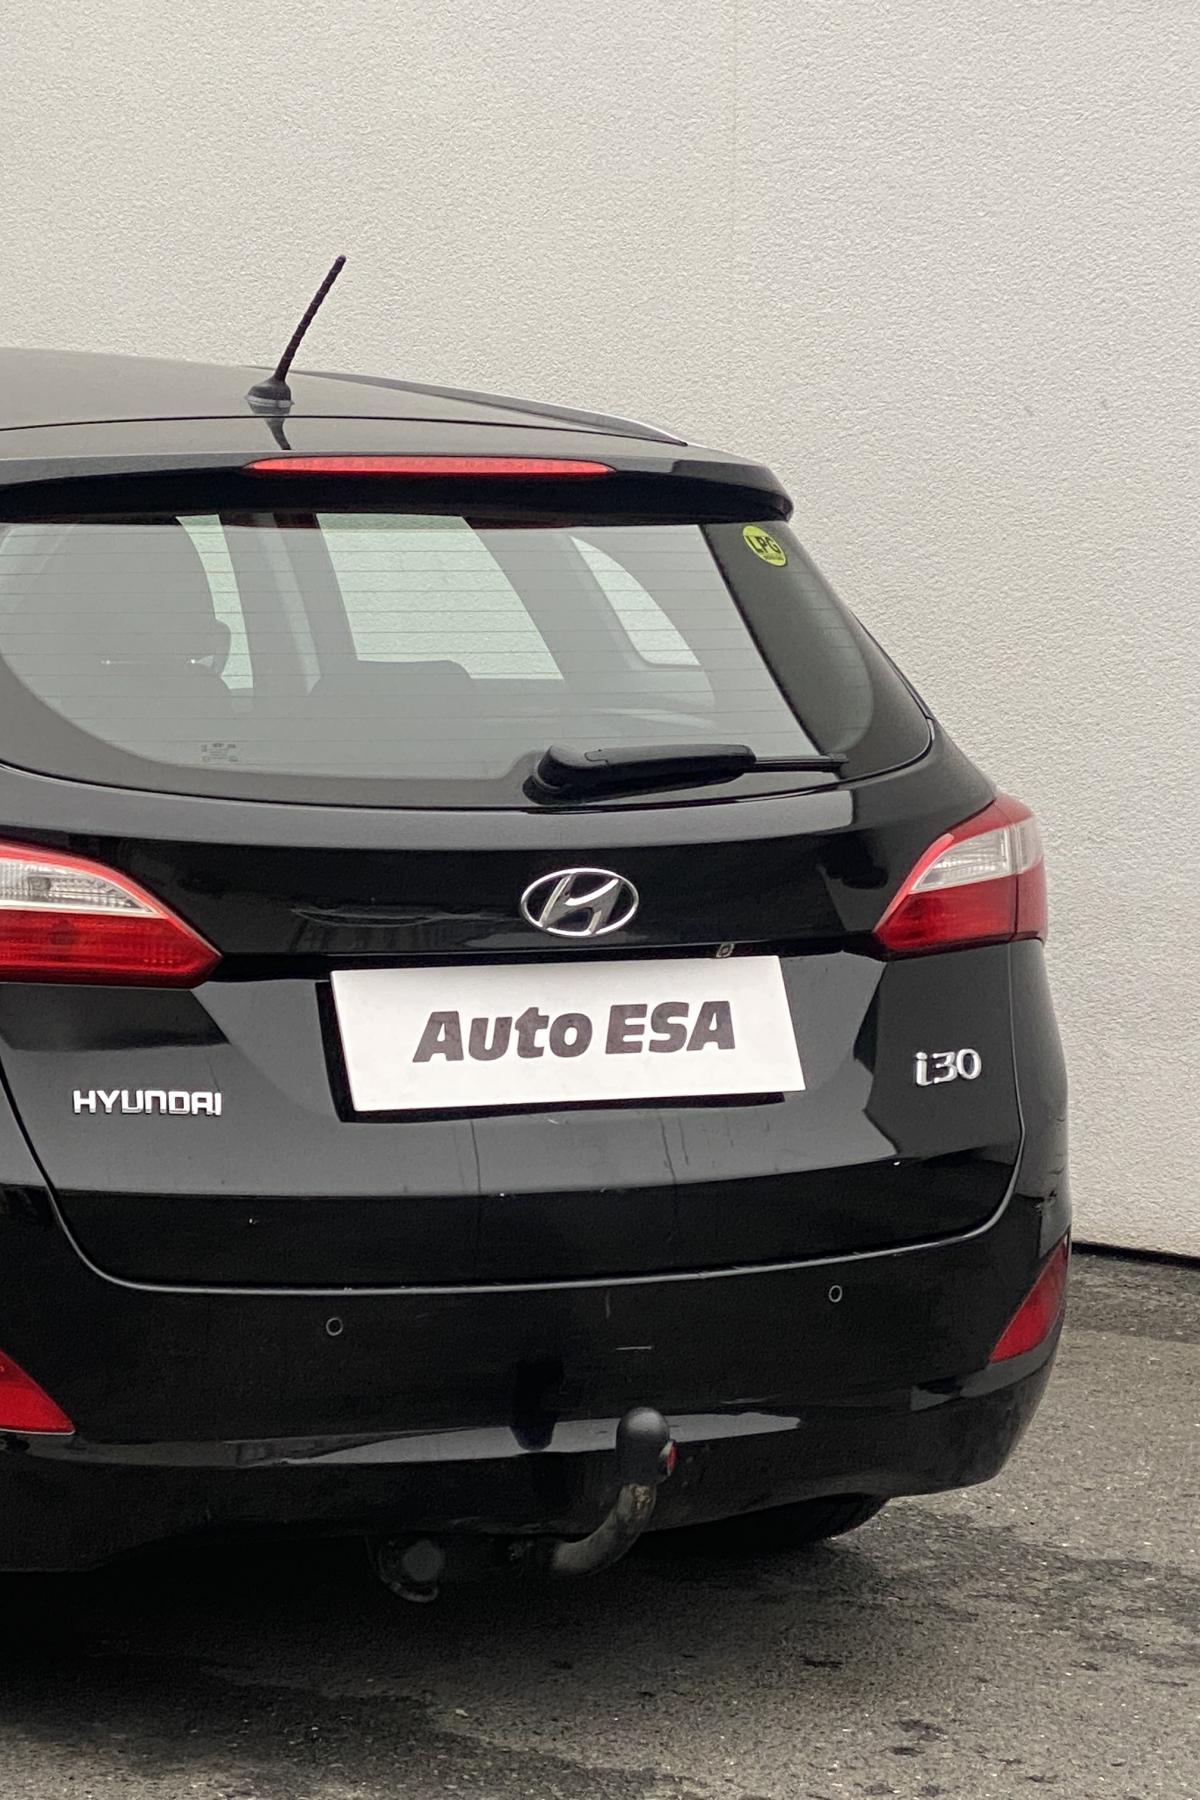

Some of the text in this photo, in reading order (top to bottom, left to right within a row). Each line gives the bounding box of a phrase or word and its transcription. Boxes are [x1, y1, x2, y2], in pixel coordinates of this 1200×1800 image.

[745, 535, 782, 554] LPG
[412, 1000, 736, 1063] Auto ESA
[915, 1048, 982, 1086] i30
[72, 1089, 222, 1116] HYUNDAI
